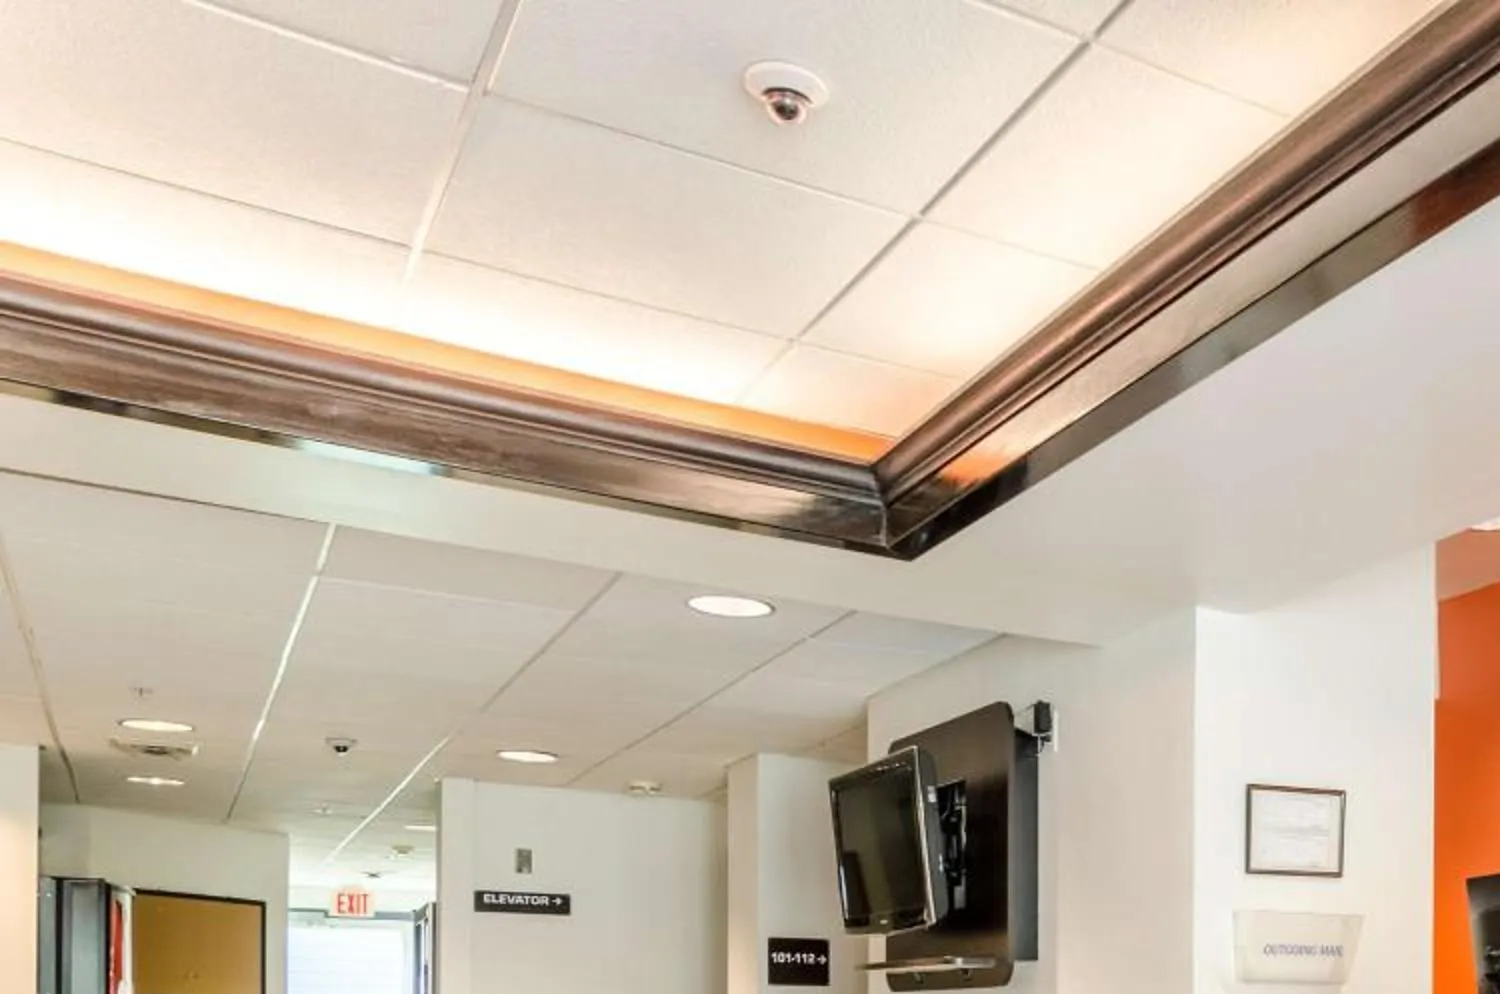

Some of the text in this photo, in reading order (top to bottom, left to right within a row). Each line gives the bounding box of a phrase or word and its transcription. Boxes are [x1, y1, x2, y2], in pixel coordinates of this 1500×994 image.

[336, 892, 369, 914] EXIT
[483, 893, 550, 906] ELEVATOR
[1262, 943, 1317, 957] OUTGOING
[771, 951, 815, 964] 101-112
